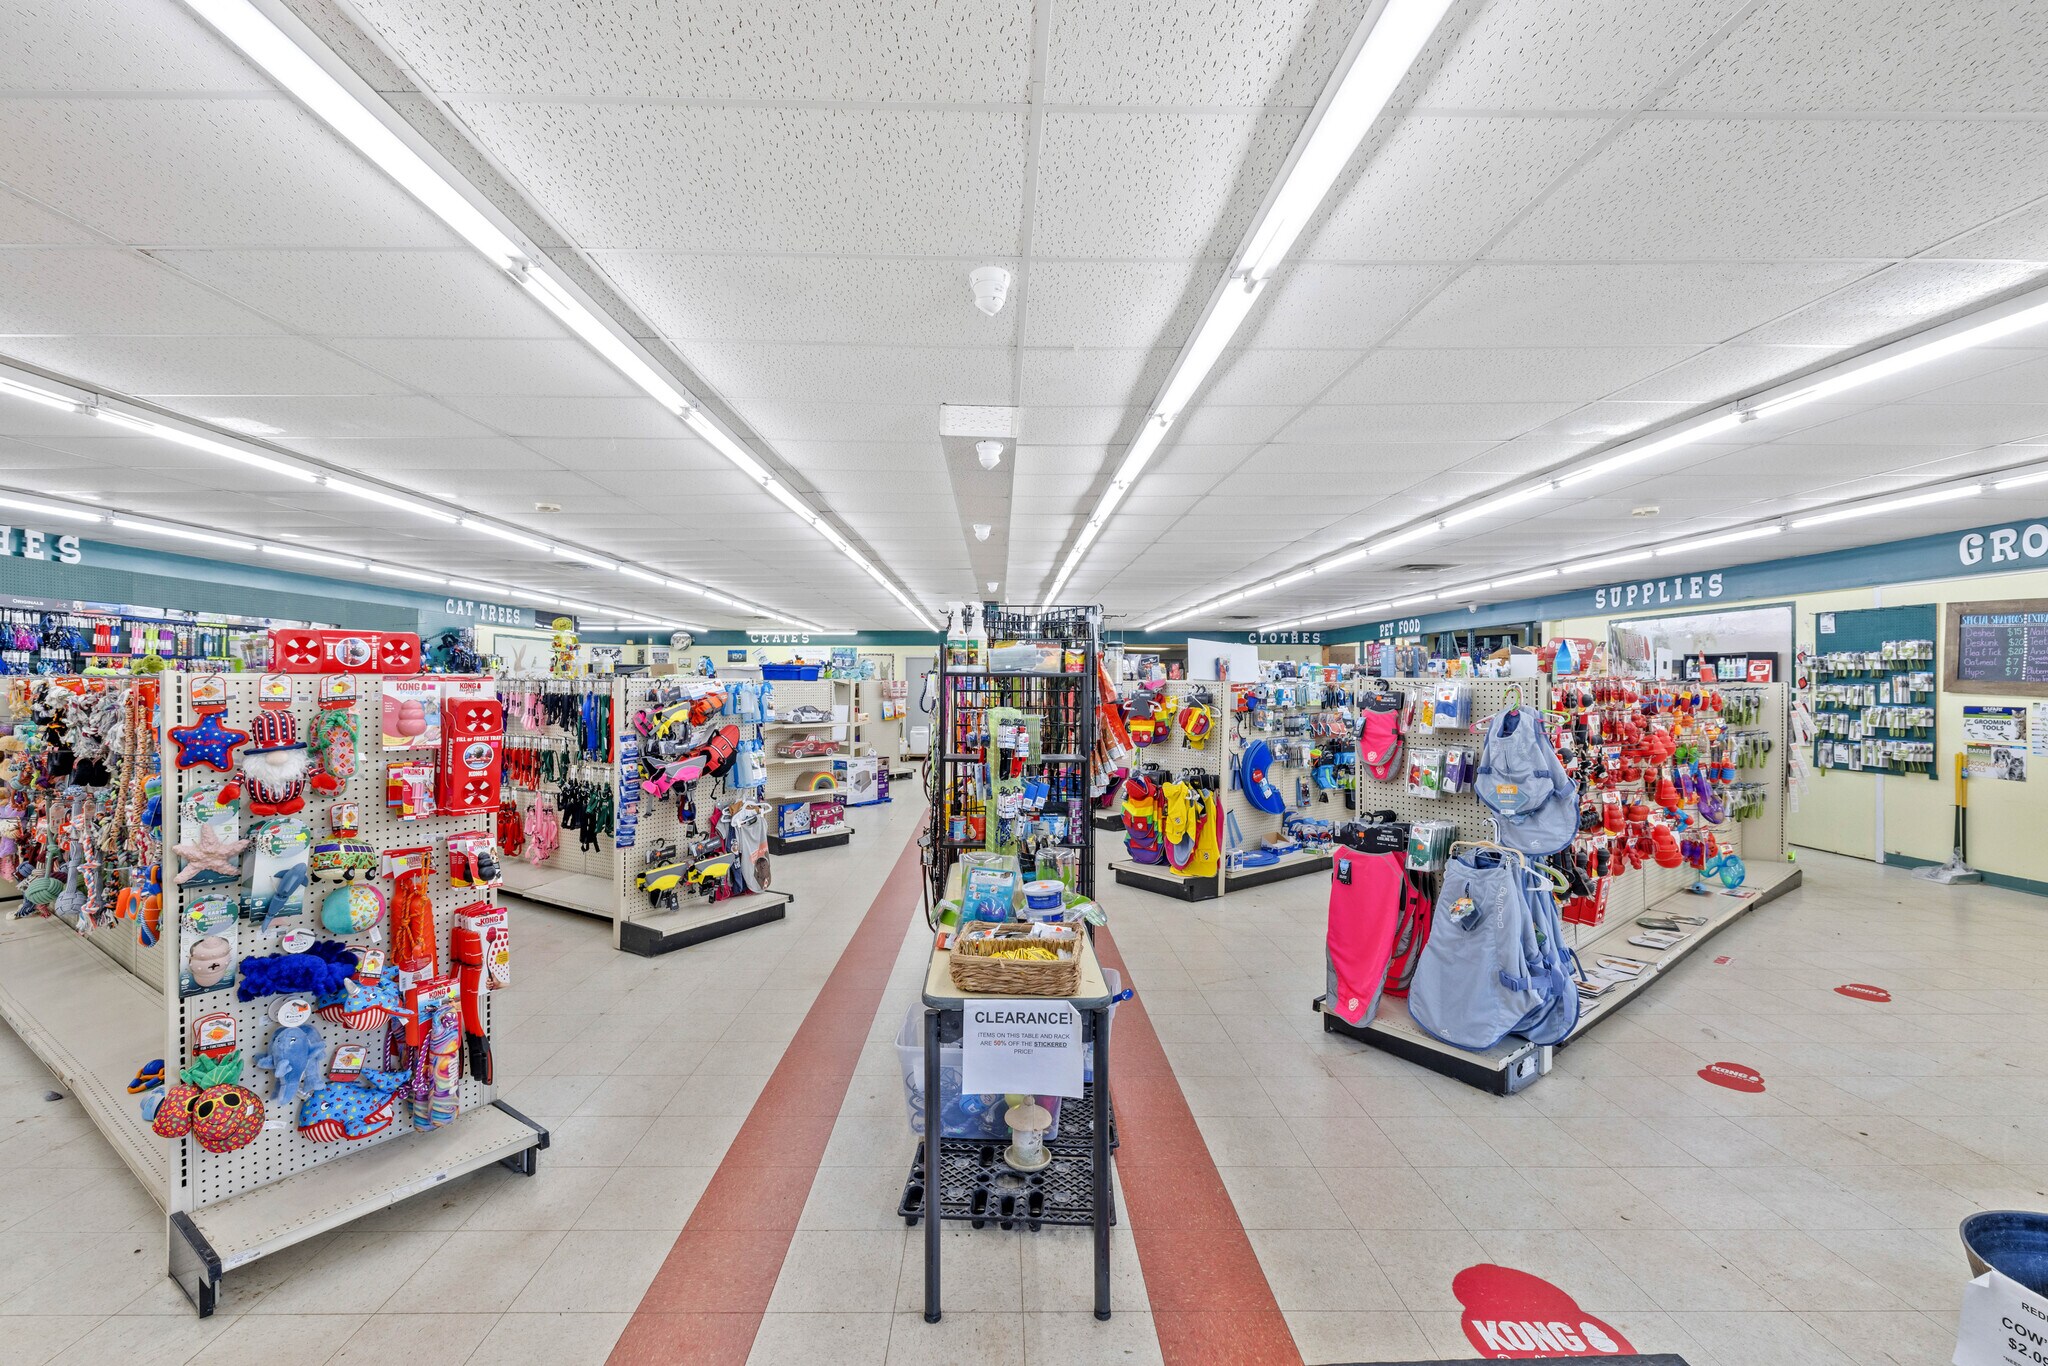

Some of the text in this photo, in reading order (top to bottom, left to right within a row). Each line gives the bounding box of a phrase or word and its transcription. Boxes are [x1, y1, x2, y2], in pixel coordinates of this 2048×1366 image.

[1960, 524, 2048, 566] GRO
[1596, 573, 1722, 608] SUPPLIES
[445, 599, 520, 624] CAT TREES
[1962, 616, 1987, 624] SPECIAL
[1380, 619, 1420, 637] PET FOOD
[1965, 627, 2022, 637] Deshed $15
[751, 634, 809, 643] CRATES
[1248, 632, 1320, 644] CLOTHES
[1966, 638, 2024, 647] Deskunk $20
[1965, 648, 1980, 656] Flea
[1988, 648, 2001, 656] Tick
[2008, 648, 2023, 656] $20
[1964, 658, 1997, 666] Oatmeal
[1965, 668, 1985, 679] Hypo
[396, 683, 420, 691] KONG
[1496, 887, 1507, 928] cooling
[480, 916, 498, 924] KONG
[429, 988, 446, 998] KONG
[975, 1012, 1073, 1024] CLEARANCE!
[1711, 1066, 1748, 1079] KONG
[1471, 1320, 1587, 1352] KONG
